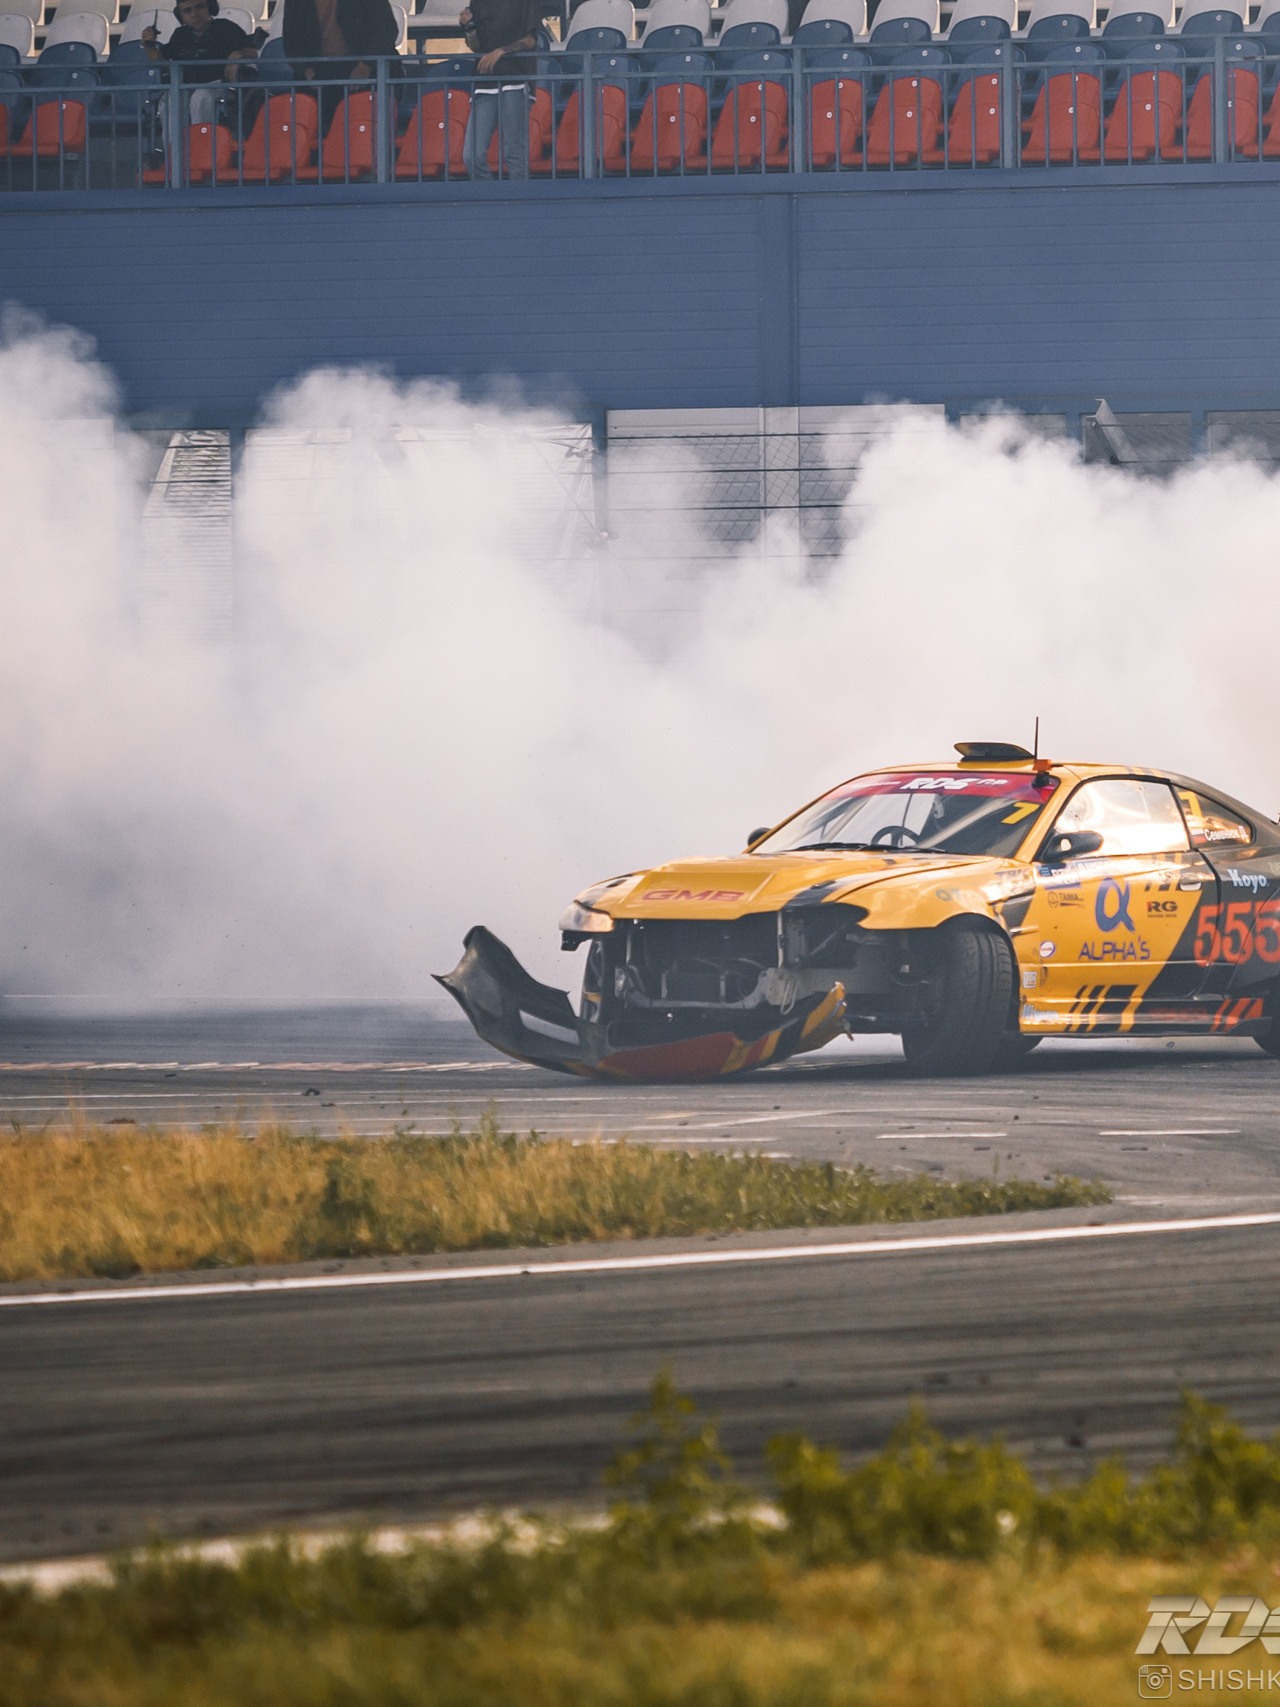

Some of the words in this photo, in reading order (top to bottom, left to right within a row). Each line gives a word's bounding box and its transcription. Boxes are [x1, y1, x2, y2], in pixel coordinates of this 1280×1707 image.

[900, 777, 980, 790] RDS
[1001, 802, 1040, 825] 7
[1227, 869, 1268, 894] Koyo
[641, 889, 745, 901] GMB
[1147, 901, 1178, 912] RG
[1078, 936, 1151, 961] ALPHA'S
